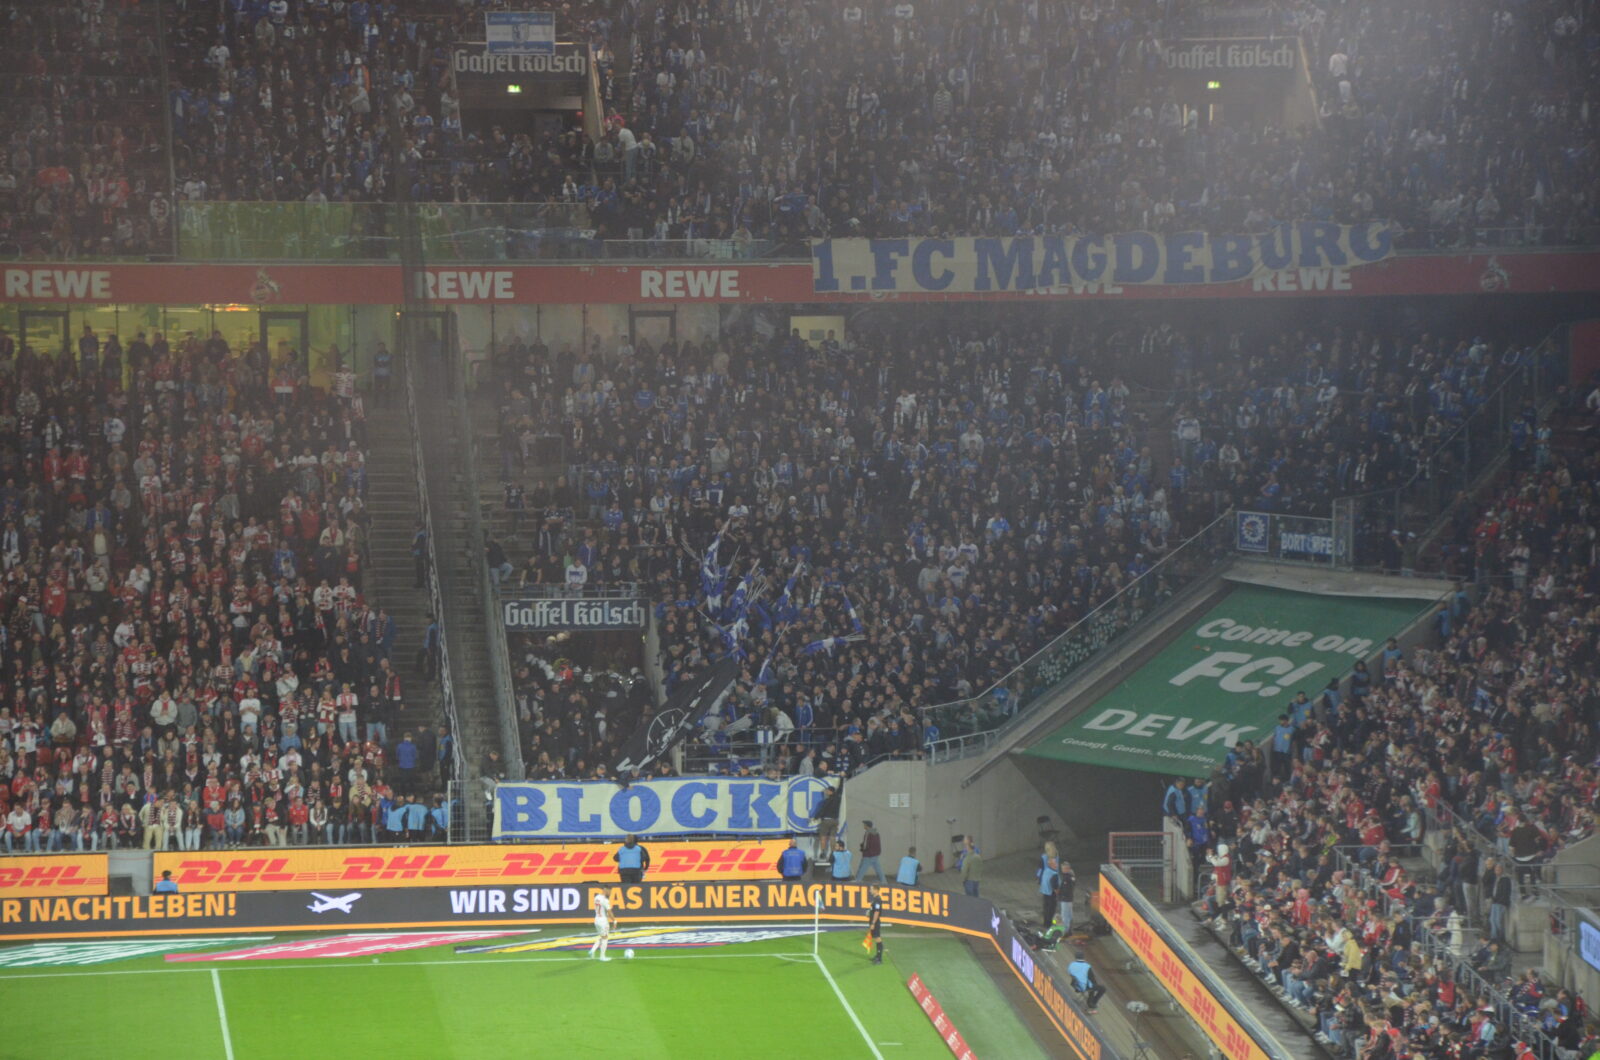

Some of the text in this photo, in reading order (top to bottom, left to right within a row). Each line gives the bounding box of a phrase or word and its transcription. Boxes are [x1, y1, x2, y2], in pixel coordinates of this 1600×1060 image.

[974, 219, 1393, 292] MAGDEBURG
[4, 269, 112, 298] REWE
[414, 270, 515, 299] REWE
[640, 269, 740, 298] REWE
[1252, 266, 1353, 291] REWE
[504, 600, 645, 628] Gaffel Kölsch
[1196, 618, 1314, 647] Come
[1168, 651, 1326, 697] FC!
[1082, 708, 1259, 749] DEVK
[498, 782, 782, 833] BLOCK
[177, 858, 296, 884] DHL
[338, 854, 457, 881] DHL
[500, 851, 617, 876] DHL
[659, 848, 776, 873] DHL
[0, 866, 87, 888] DHL
[30, 892, 237, 922] NACHTLEBEN!
[450, 889, 506, 914] WIR
[512, 887, 580, 913] SIND
[650, 882, 761, 910] KÖLNER
[768, 883, 950, 917] NACHTLEBEN!
[1103, 887, 1125, 929] DHL
[1131, 918, 1154, 961] DHL
[1161, 950, 1185, 995] DHL
[1192, 985, 1218, 1034] DHL
